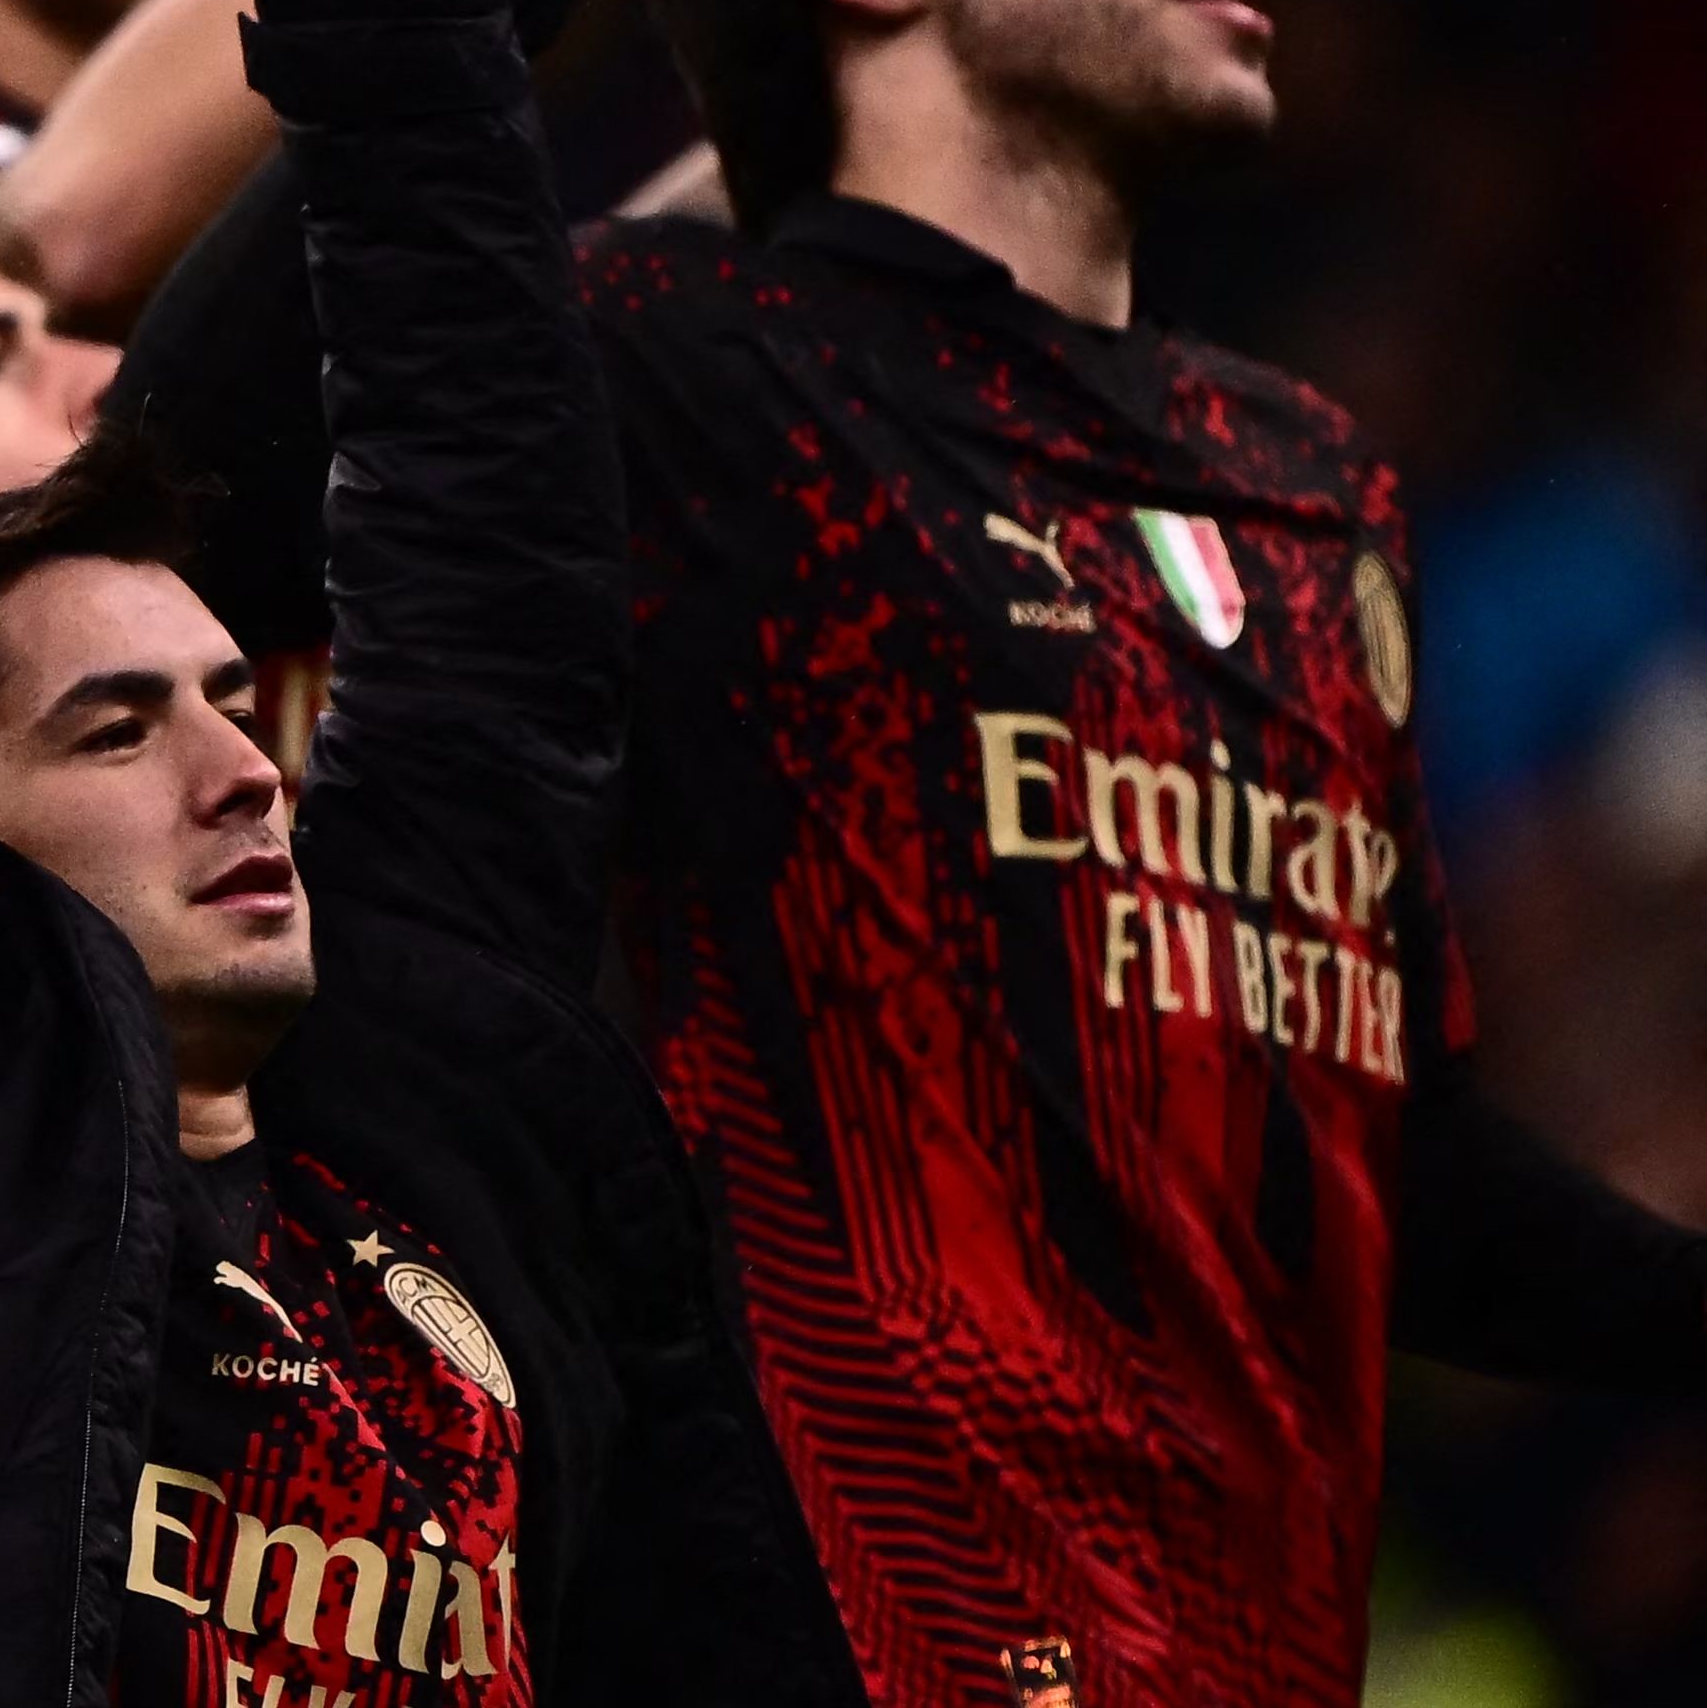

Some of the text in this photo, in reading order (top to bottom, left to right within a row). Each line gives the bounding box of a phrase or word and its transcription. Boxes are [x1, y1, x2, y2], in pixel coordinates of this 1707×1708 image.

[1103, 892, 1405, 1085] FLY BETTER
[211, 1355, 320, 1387] KOCHÉ
